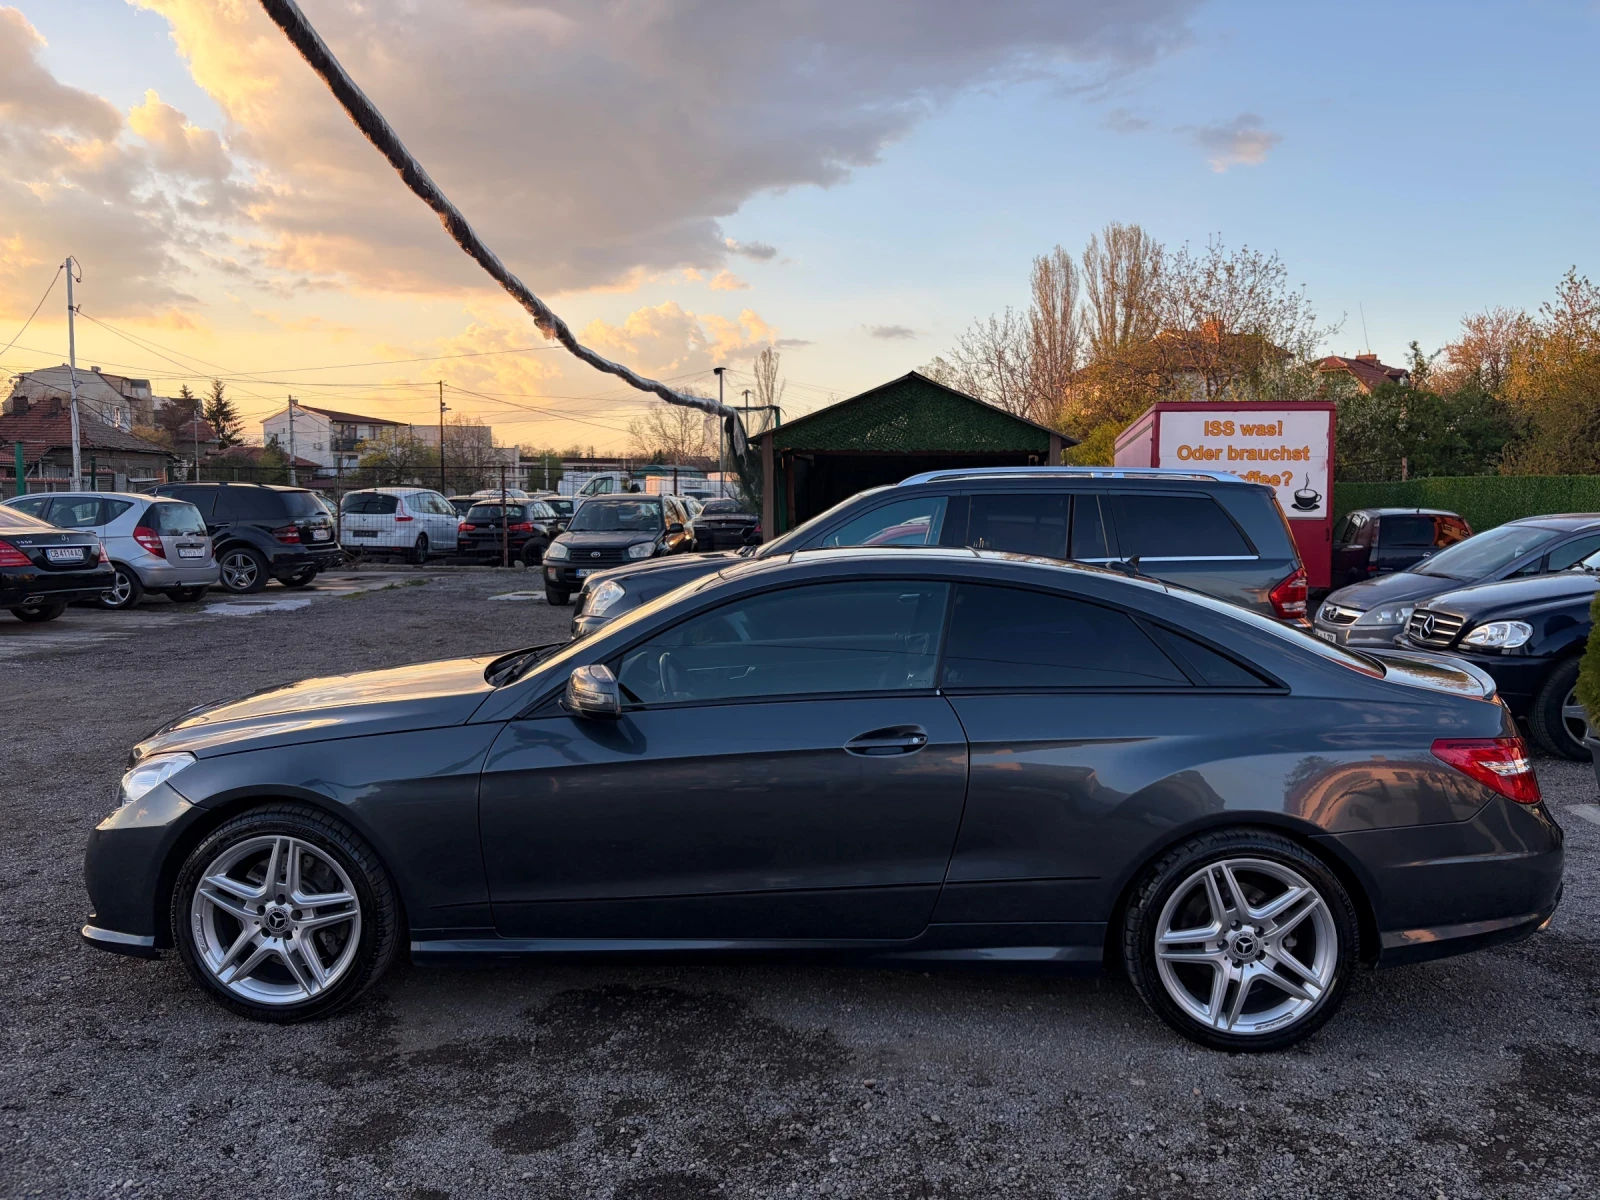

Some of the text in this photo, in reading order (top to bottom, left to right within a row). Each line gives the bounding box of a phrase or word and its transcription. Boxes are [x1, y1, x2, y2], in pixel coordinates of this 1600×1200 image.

[1204, 420, 1283, 436] ISS was!
[1177, 445, 1310, 461] Oder brauchst
